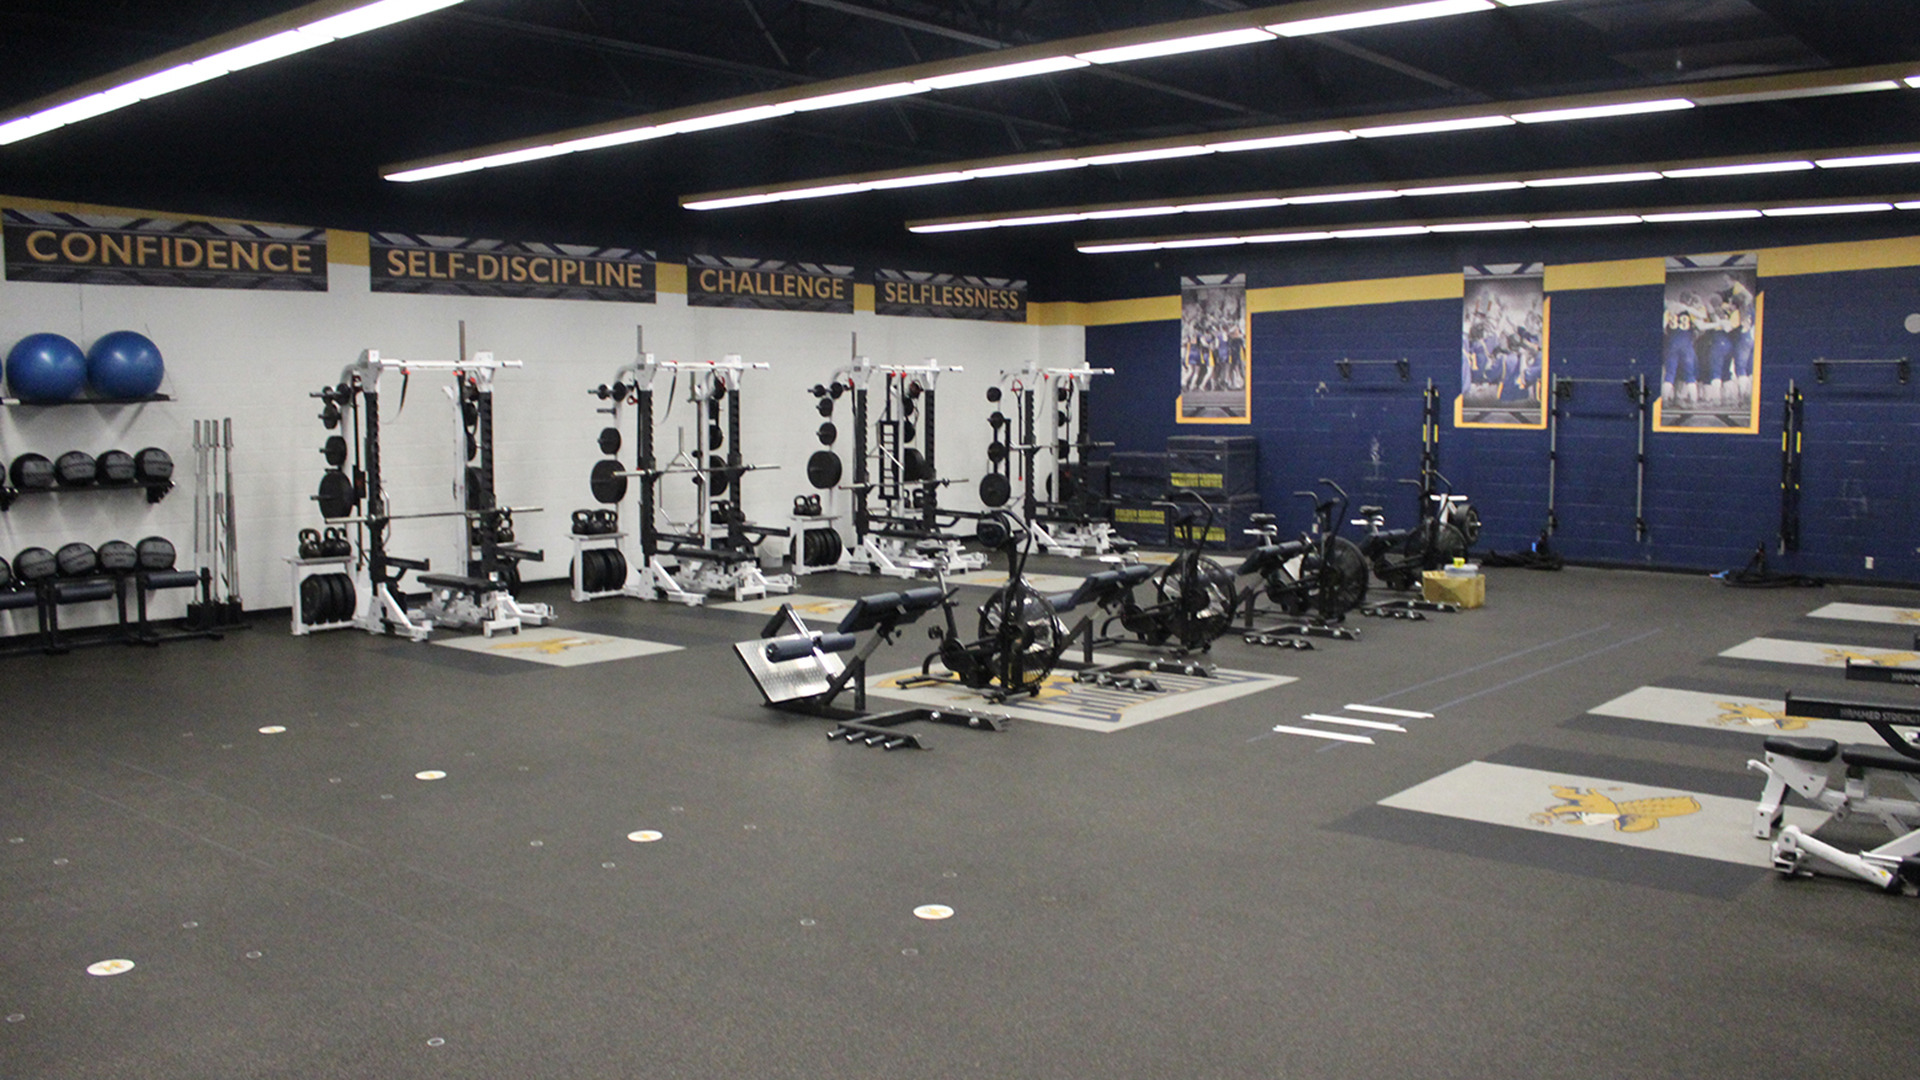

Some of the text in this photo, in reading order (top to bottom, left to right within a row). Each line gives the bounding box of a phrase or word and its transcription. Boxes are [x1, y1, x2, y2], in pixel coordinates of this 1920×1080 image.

[26, 230, 312, 273] CONFIDENCE
[387, 249, 643, 288] SELF-DISCIPLINE
[700, 269, 844, 299] CHALLENGE
[885, 281, 1019, 310] SELFLESSNESS
